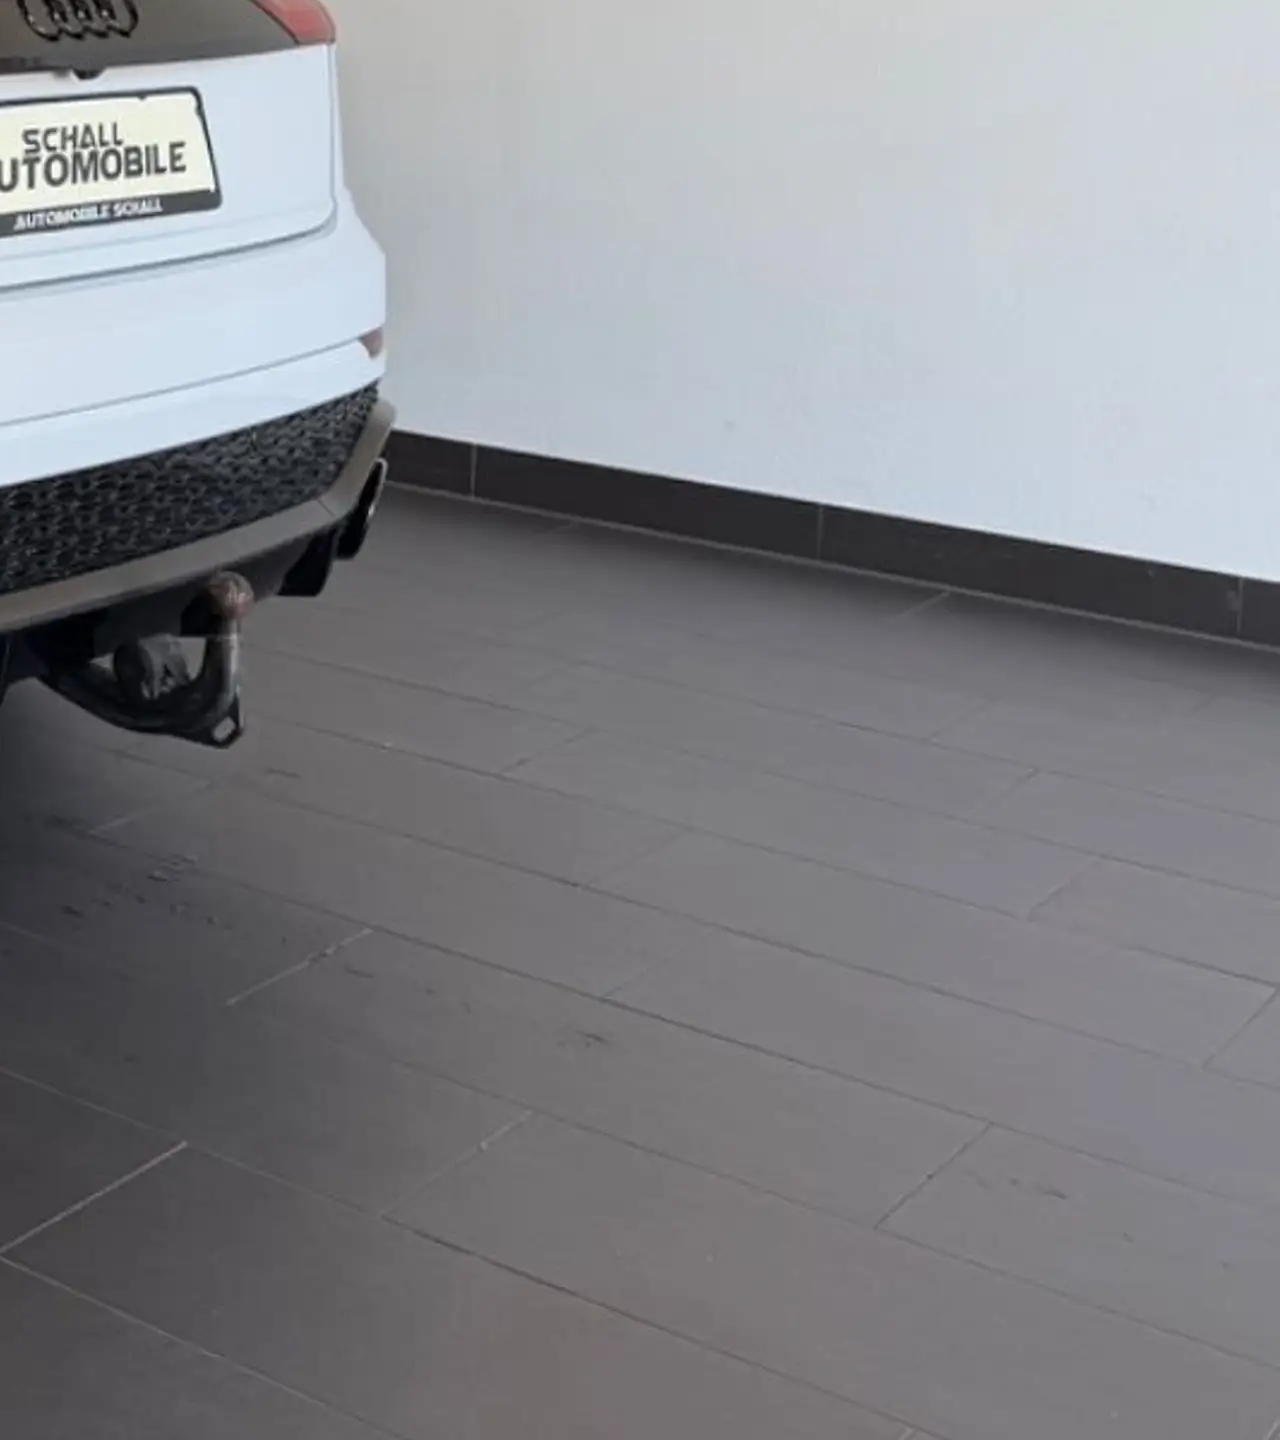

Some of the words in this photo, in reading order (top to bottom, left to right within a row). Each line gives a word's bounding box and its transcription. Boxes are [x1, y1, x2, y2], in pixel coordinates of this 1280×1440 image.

[22, 122, 124, 155] SCHALL
[13, 203, 110, 231] AUTOMOBILE
[113, 197, 163, 218] SCHALL
